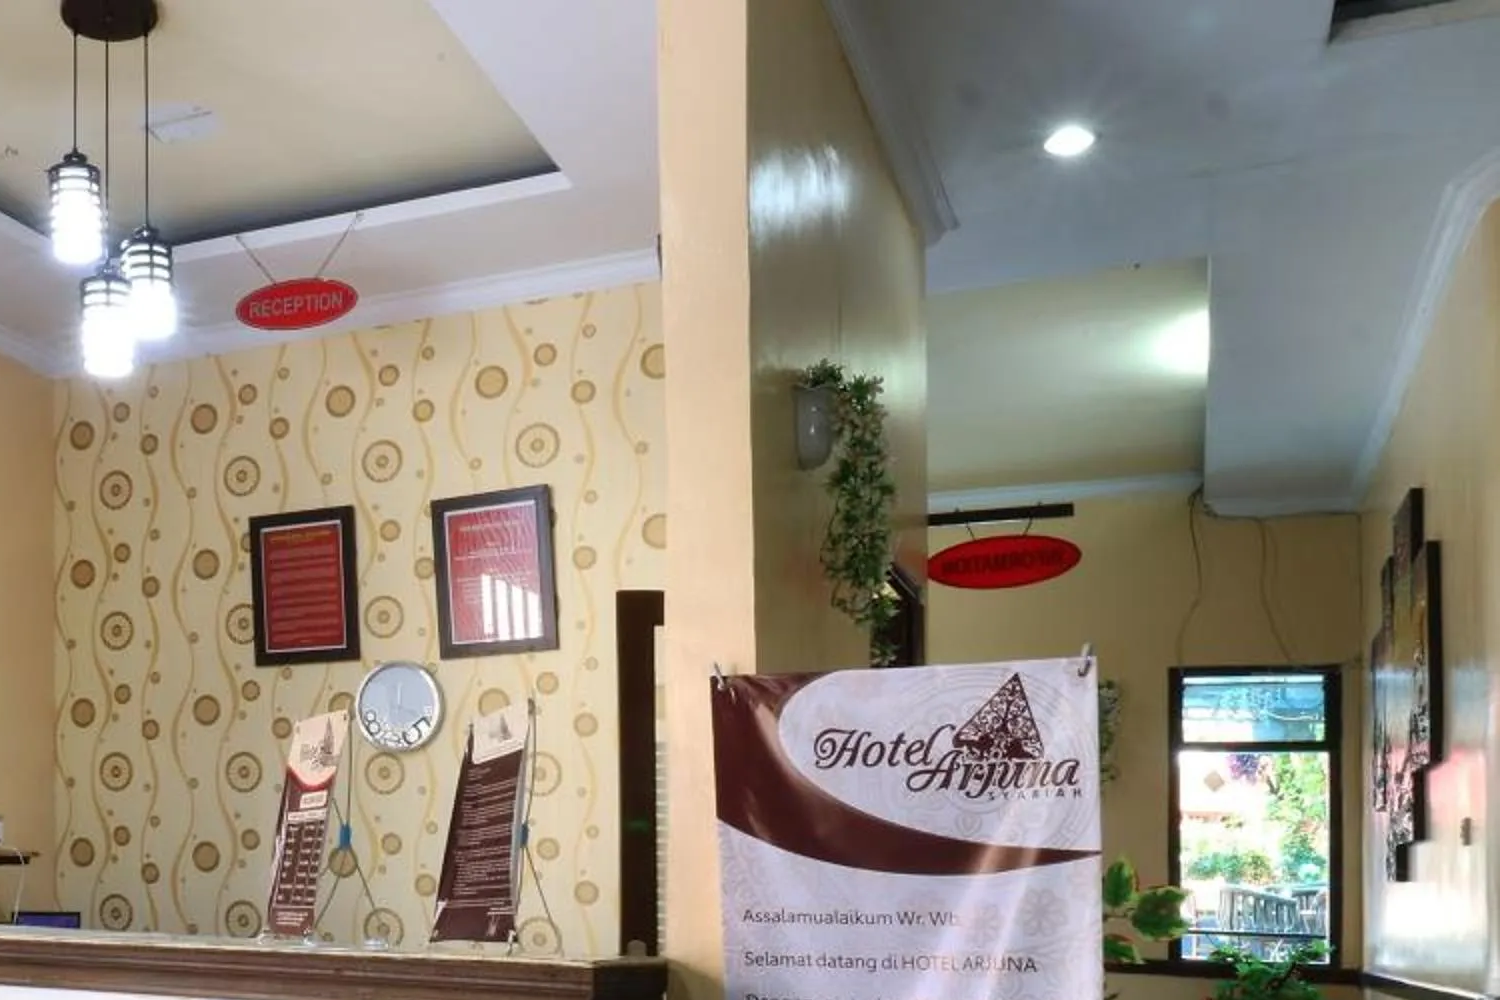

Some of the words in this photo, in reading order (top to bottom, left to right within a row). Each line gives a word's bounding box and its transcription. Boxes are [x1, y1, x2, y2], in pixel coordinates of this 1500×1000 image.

[248, 290, 344, 319] RECEPTION
[813, 724, 956, 769] Hotel
[906, 749, 1080, 799] Arjuna
[743, 908, 893, 926] Assalamualaikum
[744, 951, 812, 968] Selamat
[815, 953, 878, 973] datang
[881, 953, 898, 970] di
[902, 956, 959, 971] HOTEL
